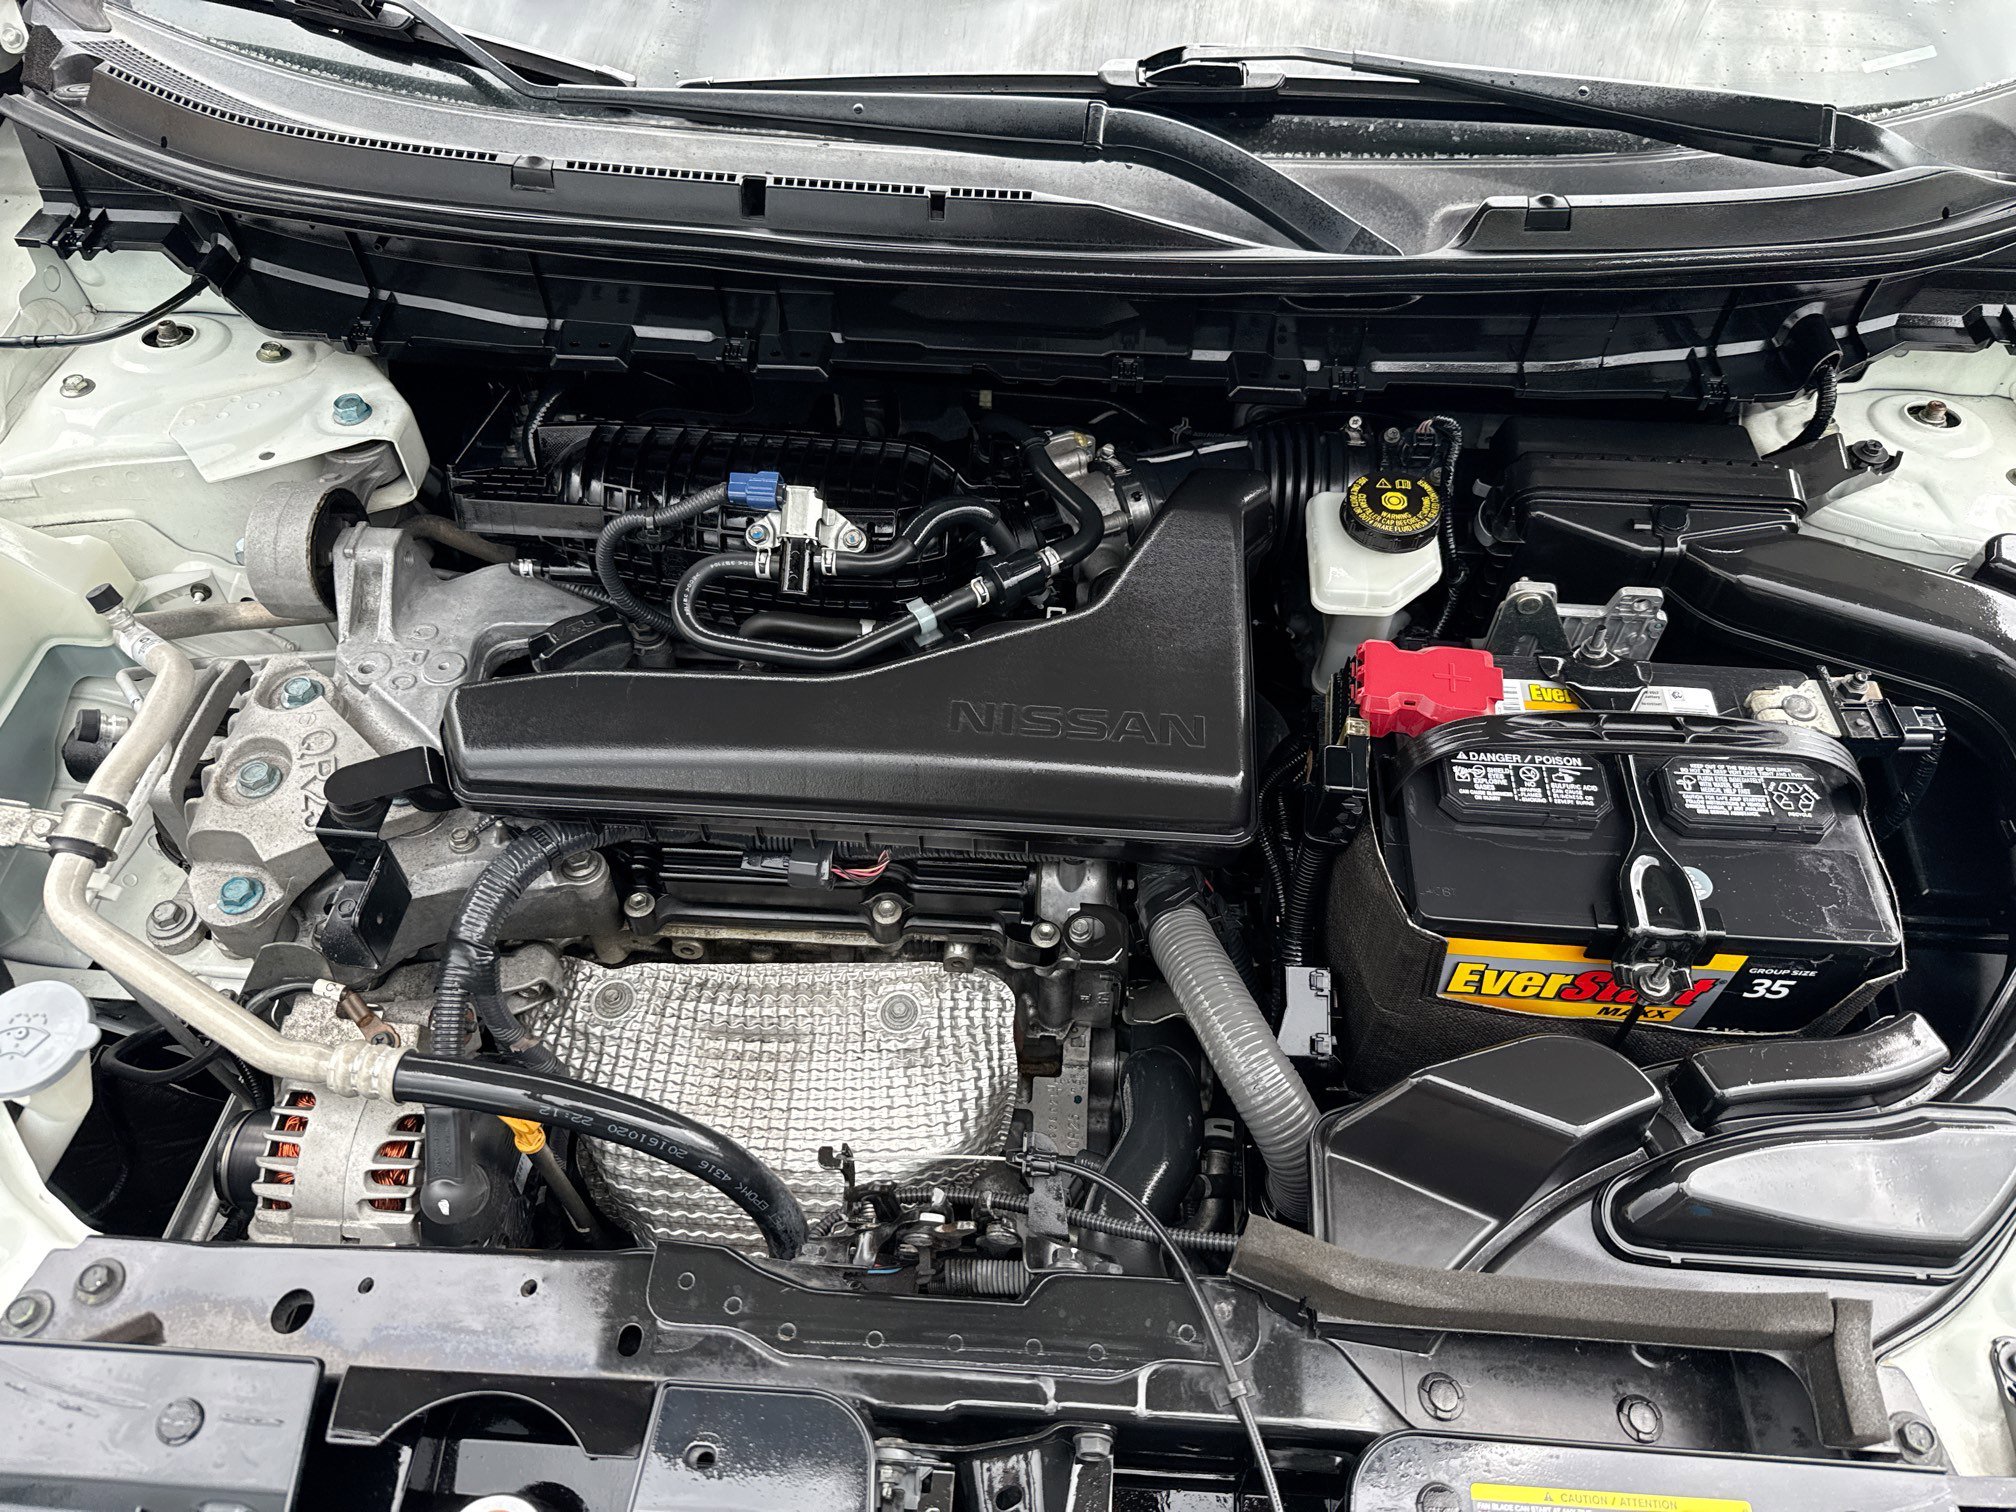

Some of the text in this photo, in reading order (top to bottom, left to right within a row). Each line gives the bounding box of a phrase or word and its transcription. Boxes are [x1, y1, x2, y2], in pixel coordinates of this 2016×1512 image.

[1381, 511, 1411, 520] WARNING
[1395, 515, 1421, 526] BEFORE
[1372, 521, 1394, 531] BRAKE
[950, 699, 1206, 748] NISSAN
[1469, 752, 1582, 766] DANGER / POISON
[1473, 777, 1508, 785] EXPLOSIVE
[1550, 782, 1582, 790] SULFURIC
[1446, 962, 1720, 1006] EverStat
[1742, 978, 1797, 999] 35
[538, 1104, 594, 1127] 22:12
[607, 1123, 688, 1160] 20161020
[699, 1160, 732, 1182] 4316
[1477, 1502, 1491, 1510] FAN
[1492, 1502, 1514, 1511] BLADE
[1514, 1504, 1530, 1512] CAN
[1560, 1493, 1608, 1505] CAUTION
[1620, 1497, 1678, 1510] ATTENTION
